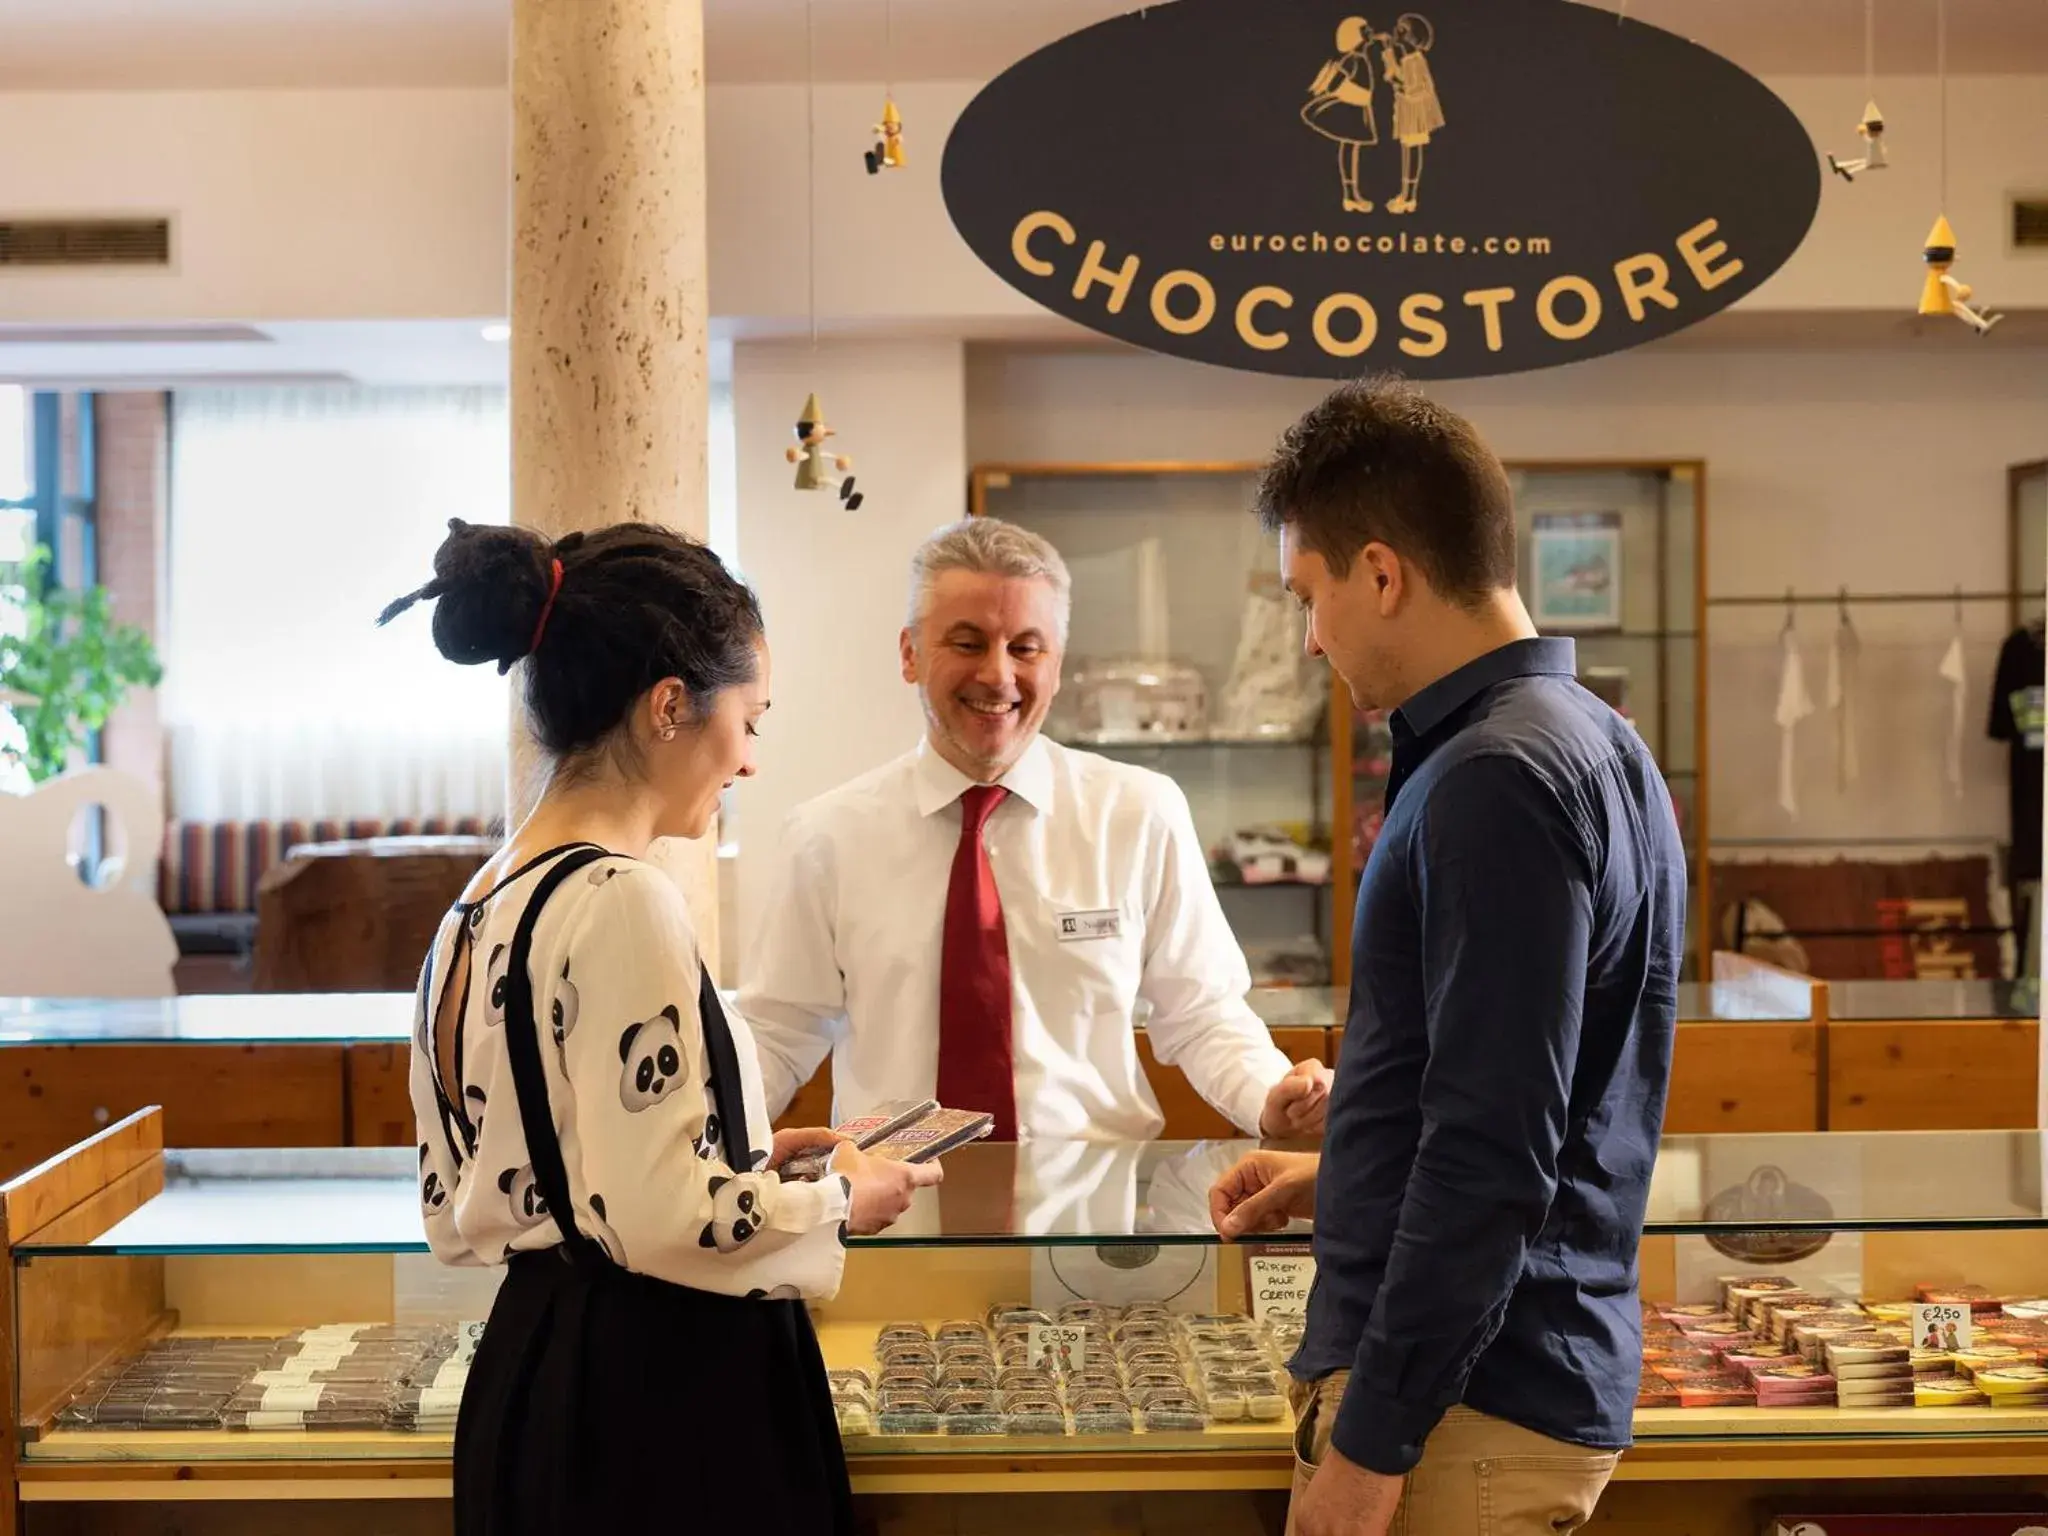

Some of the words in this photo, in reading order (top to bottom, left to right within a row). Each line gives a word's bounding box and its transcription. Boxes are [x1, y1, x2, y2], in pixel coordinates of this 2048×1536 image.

[1209, 232, 1551, 255] eurochocolate.com
[1010, 210, 1745, 358] CHOCOSTORE
[1922, 1306, 1961, 1322] €2,50
[1038, 1328, 1078, 1346] €3,50
